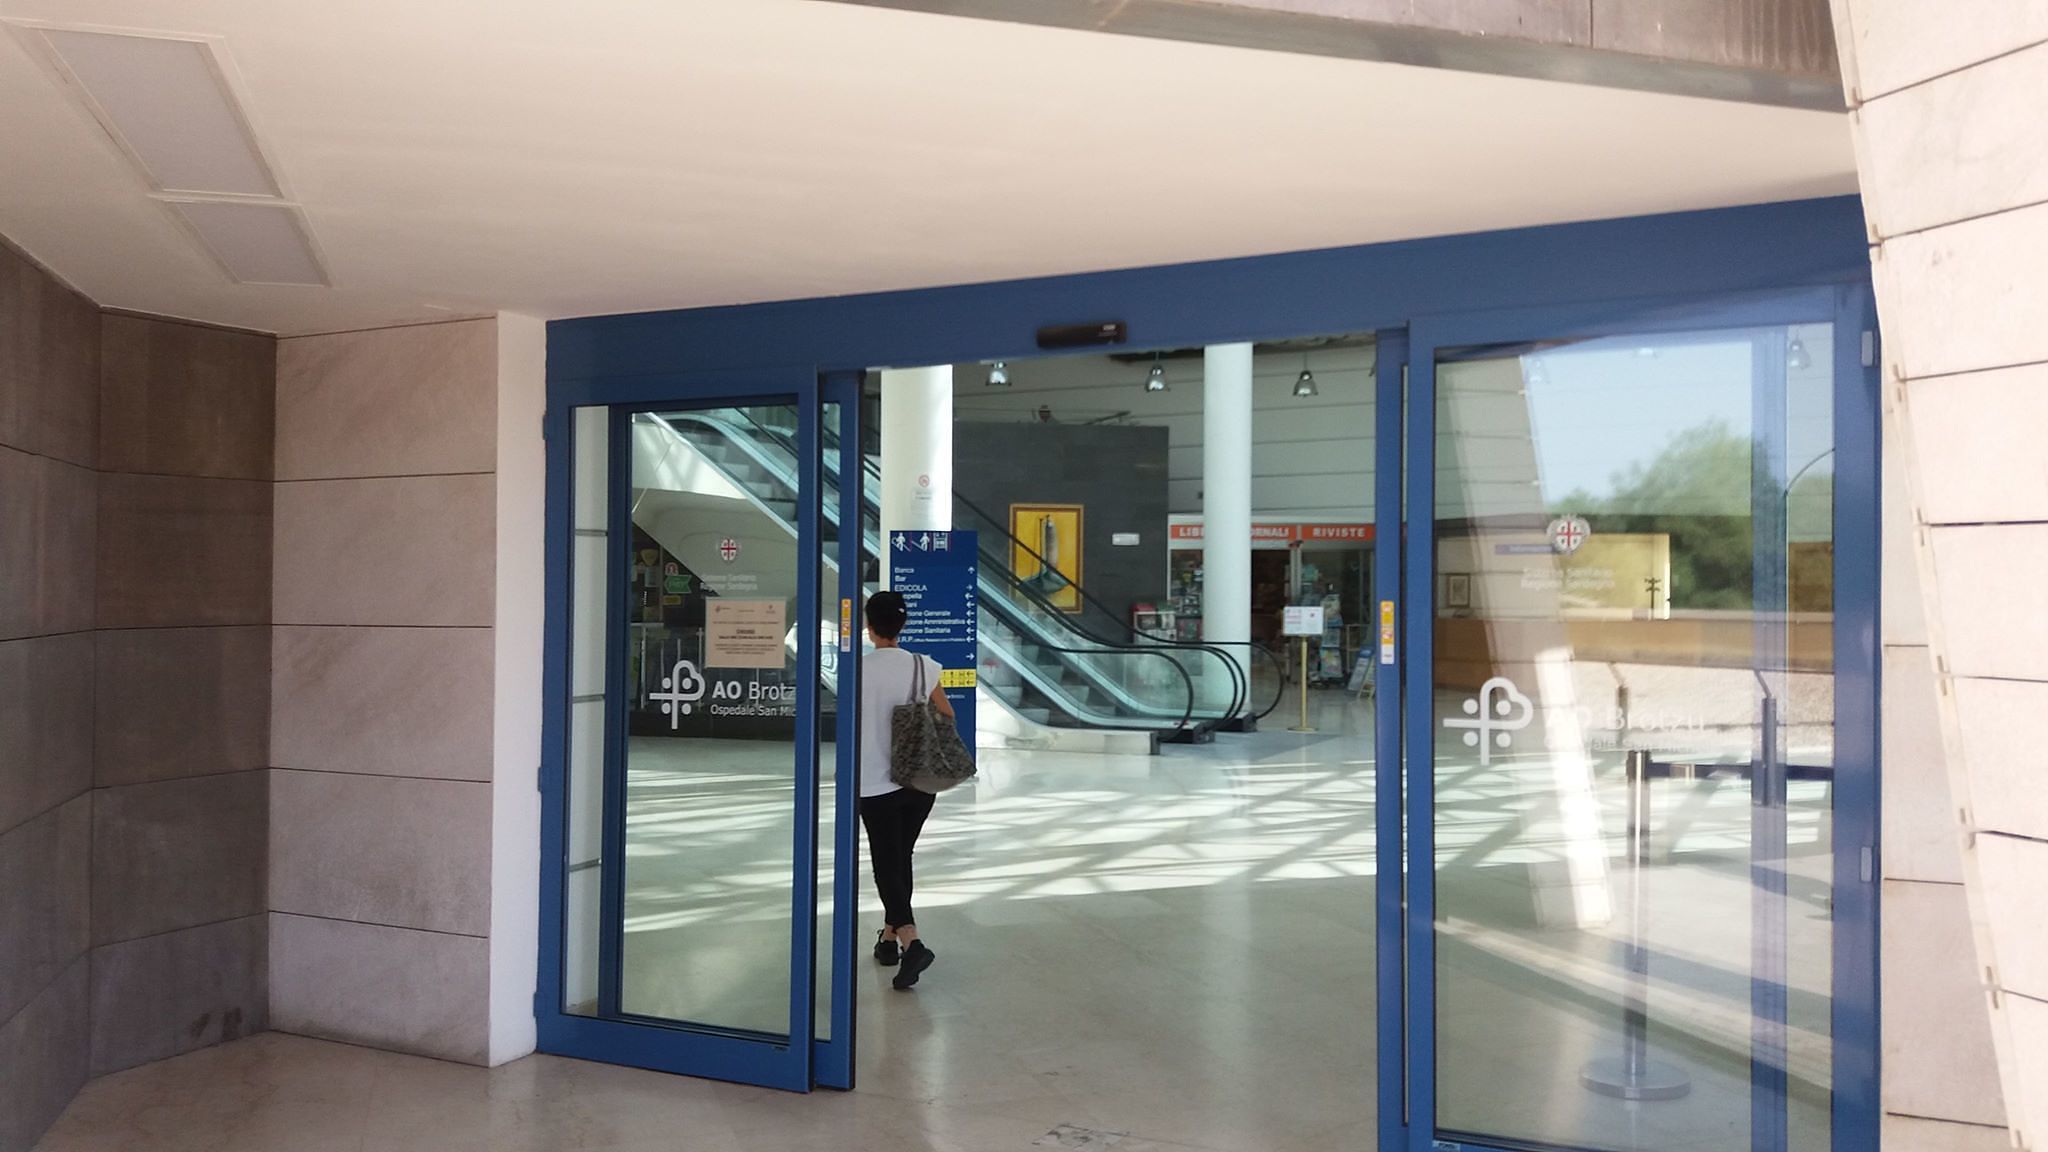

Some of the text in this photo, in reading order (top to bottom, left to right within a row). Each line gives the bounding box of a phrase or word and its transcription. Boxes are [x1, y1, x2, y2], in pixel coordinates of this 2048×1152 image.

[1312, 527, 1366, 538] RIVISTE
[894, 584, 928, 592] EDICOLA
[711, 681, 742, 699] AO
[710, 704, 756, 717] Ospedale
[758, 706, 777, 717] San
